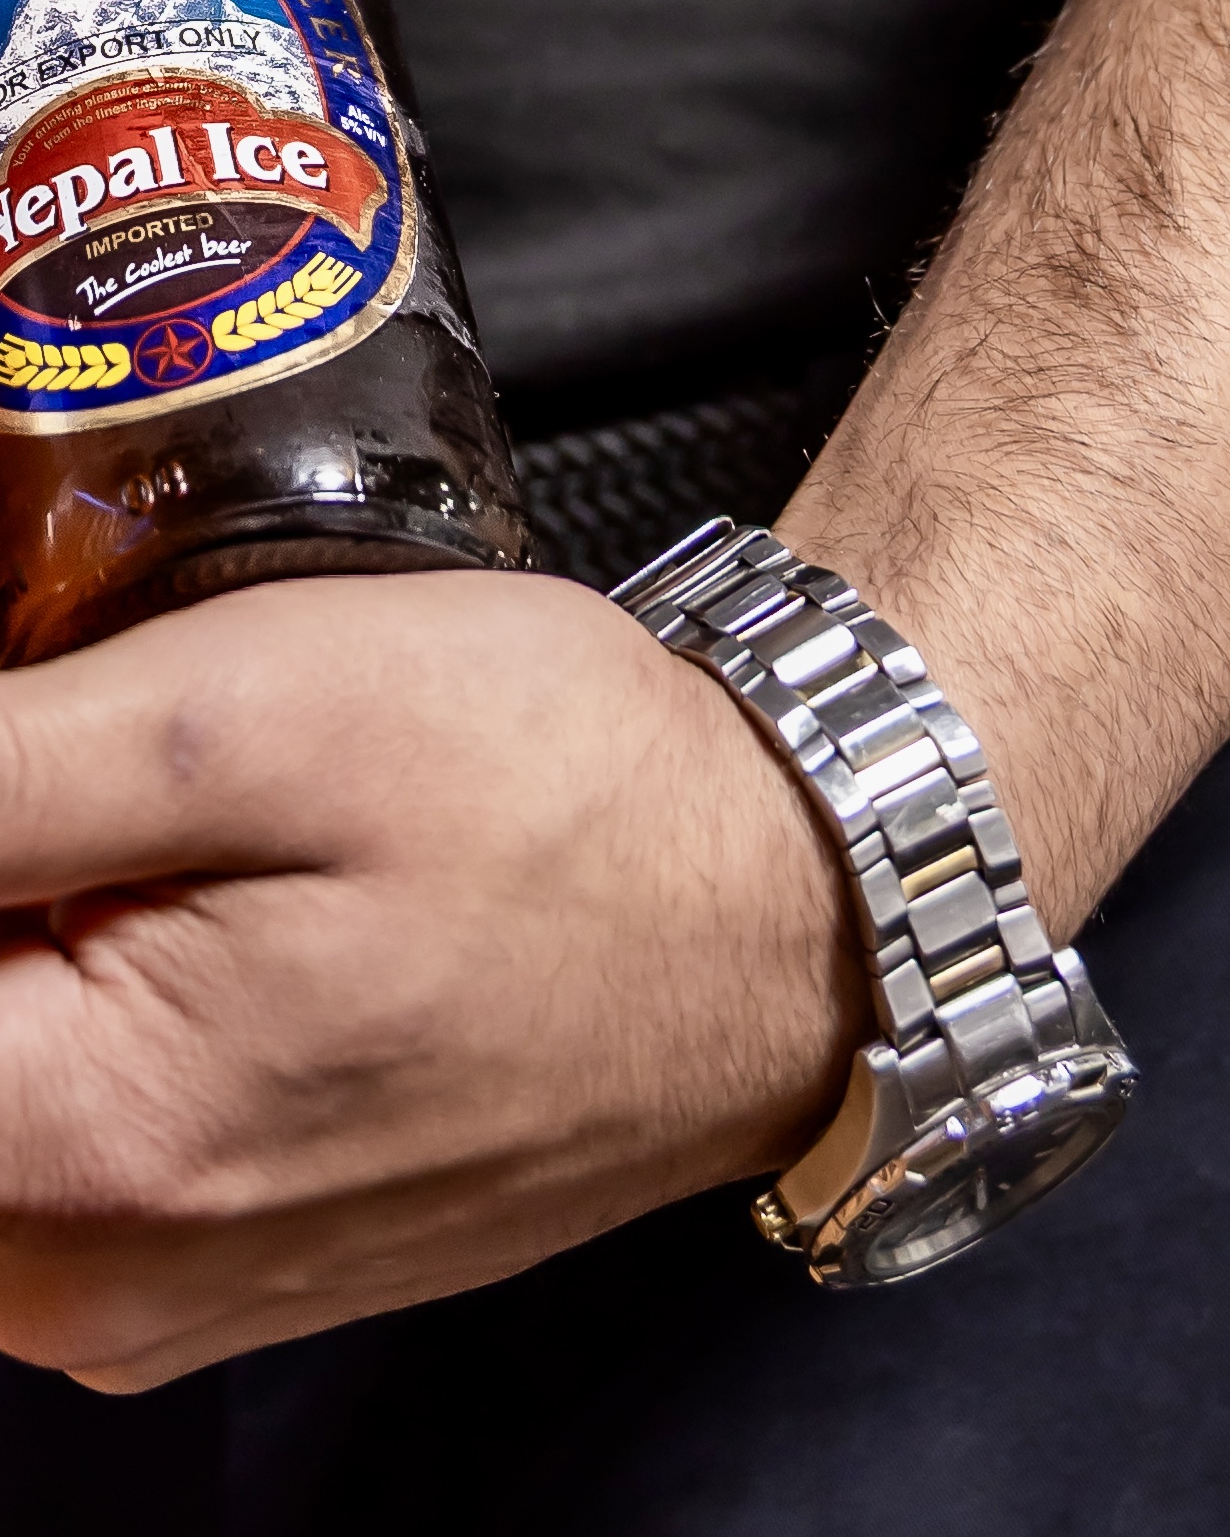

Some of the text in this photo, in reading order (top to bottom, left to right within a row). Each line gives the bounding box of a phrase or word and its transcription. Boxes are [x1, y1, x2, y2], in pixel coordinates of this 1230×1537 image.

[39, 30, 166, 82] EXPORT
[179, 26, 261, 50] ONLY
[12, 139, 35, 168] Your
[35, 104, 83, 139] drinking
[85, 84, 138, 110] pleasure
[43, 126, 71, 151] from
[73, 115, 94, 131] the
[339, 115, 363, 136] 5%
[347, 104, 375, 128] Alc.
[201, 122, 331, 190] Ice
[84, 212, 214, 260] IMPORTED
[76, 233, 253, 306] The Coolest beer
